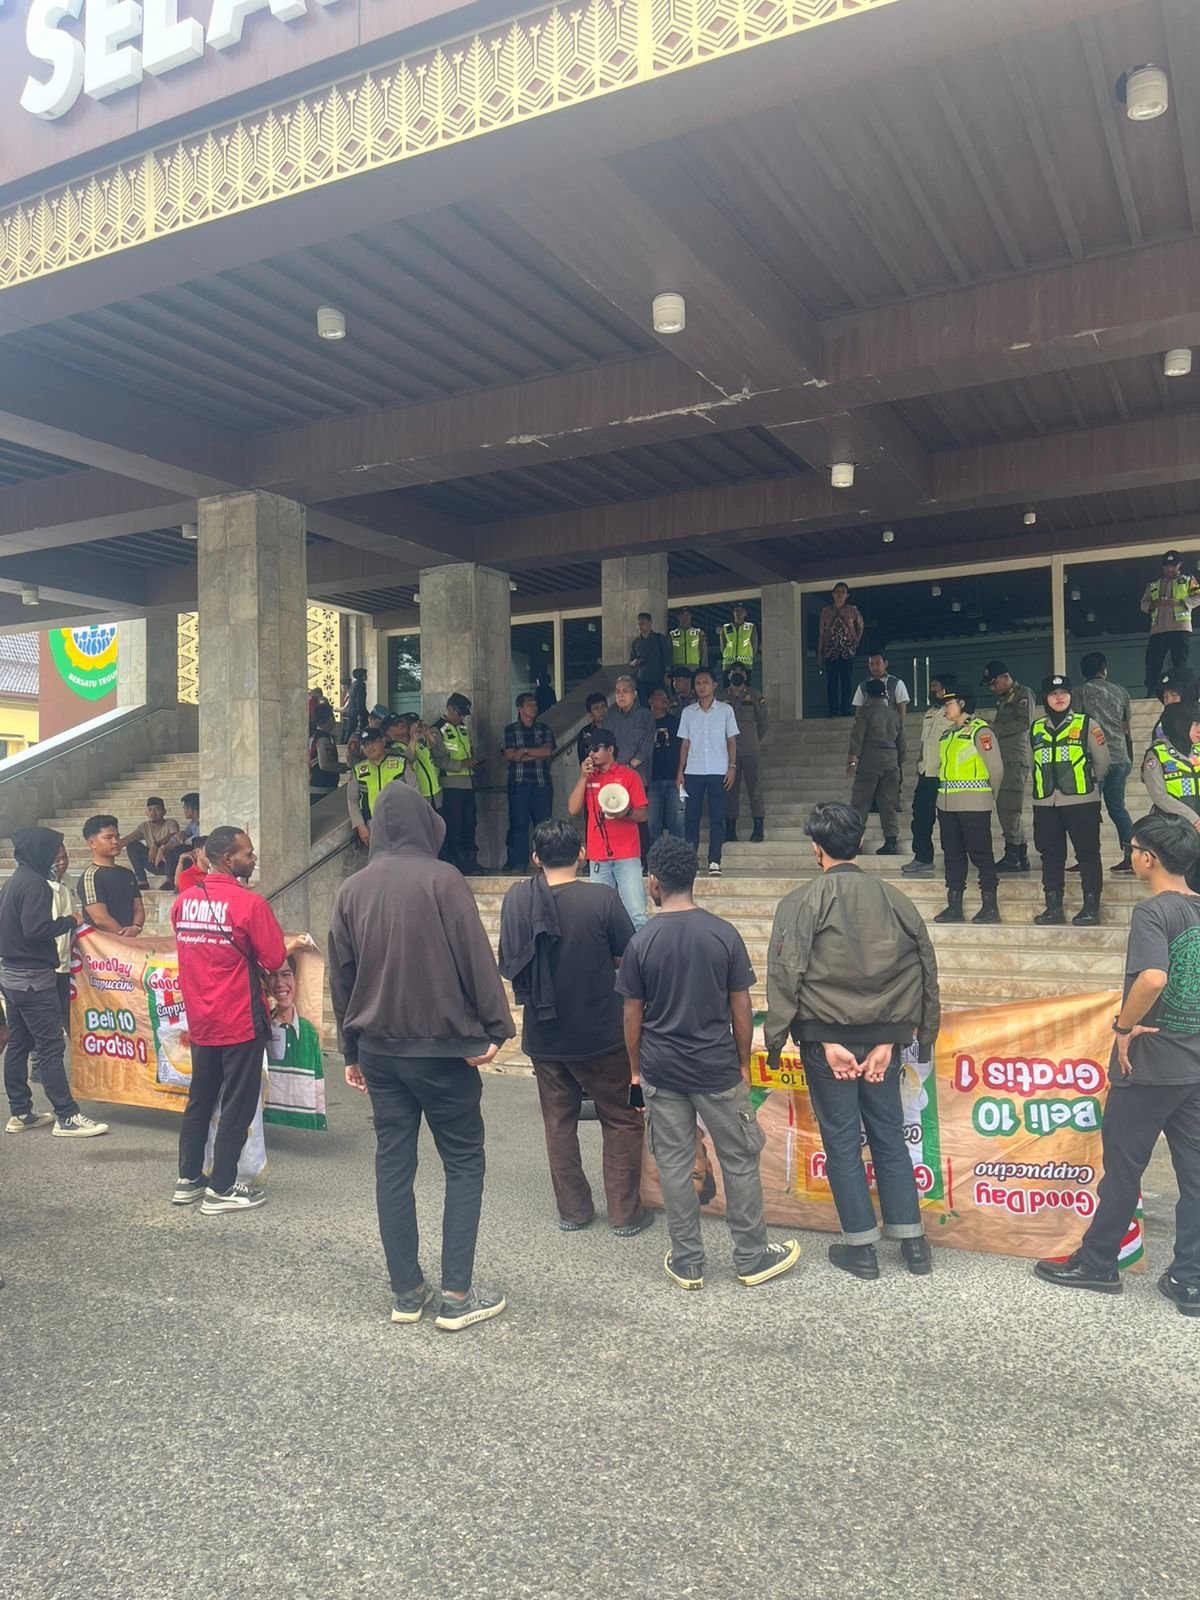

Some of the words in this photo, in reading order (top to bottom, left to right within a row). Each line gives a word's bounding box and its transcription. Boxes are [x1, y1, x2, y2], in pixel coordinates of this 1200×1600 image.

[68, 672, 97, 688] BERSATU
[182, 898, 228, 924] KOMPAS
[87, 1009, 115, 1029] Beli
[118, 1011, 134, 1031] 10
[84, 1035, 135, 1057] Gratis
[138, 1041, 146, 1061] 1
[781, 1073, 796, 1085] 10
[960, 1060, 974, 1088] 1
[987, 1061, 1100, 1092] Gratis
[978, 1101, 1015, 1131] 10
[1029, 1101, 1098, 1132] Beli
[975, 1162, 1094, 1184] Cappuccino
[975, 1182, 1026, 1214] Day
[1028, 1190, 1097, 1217] Good
